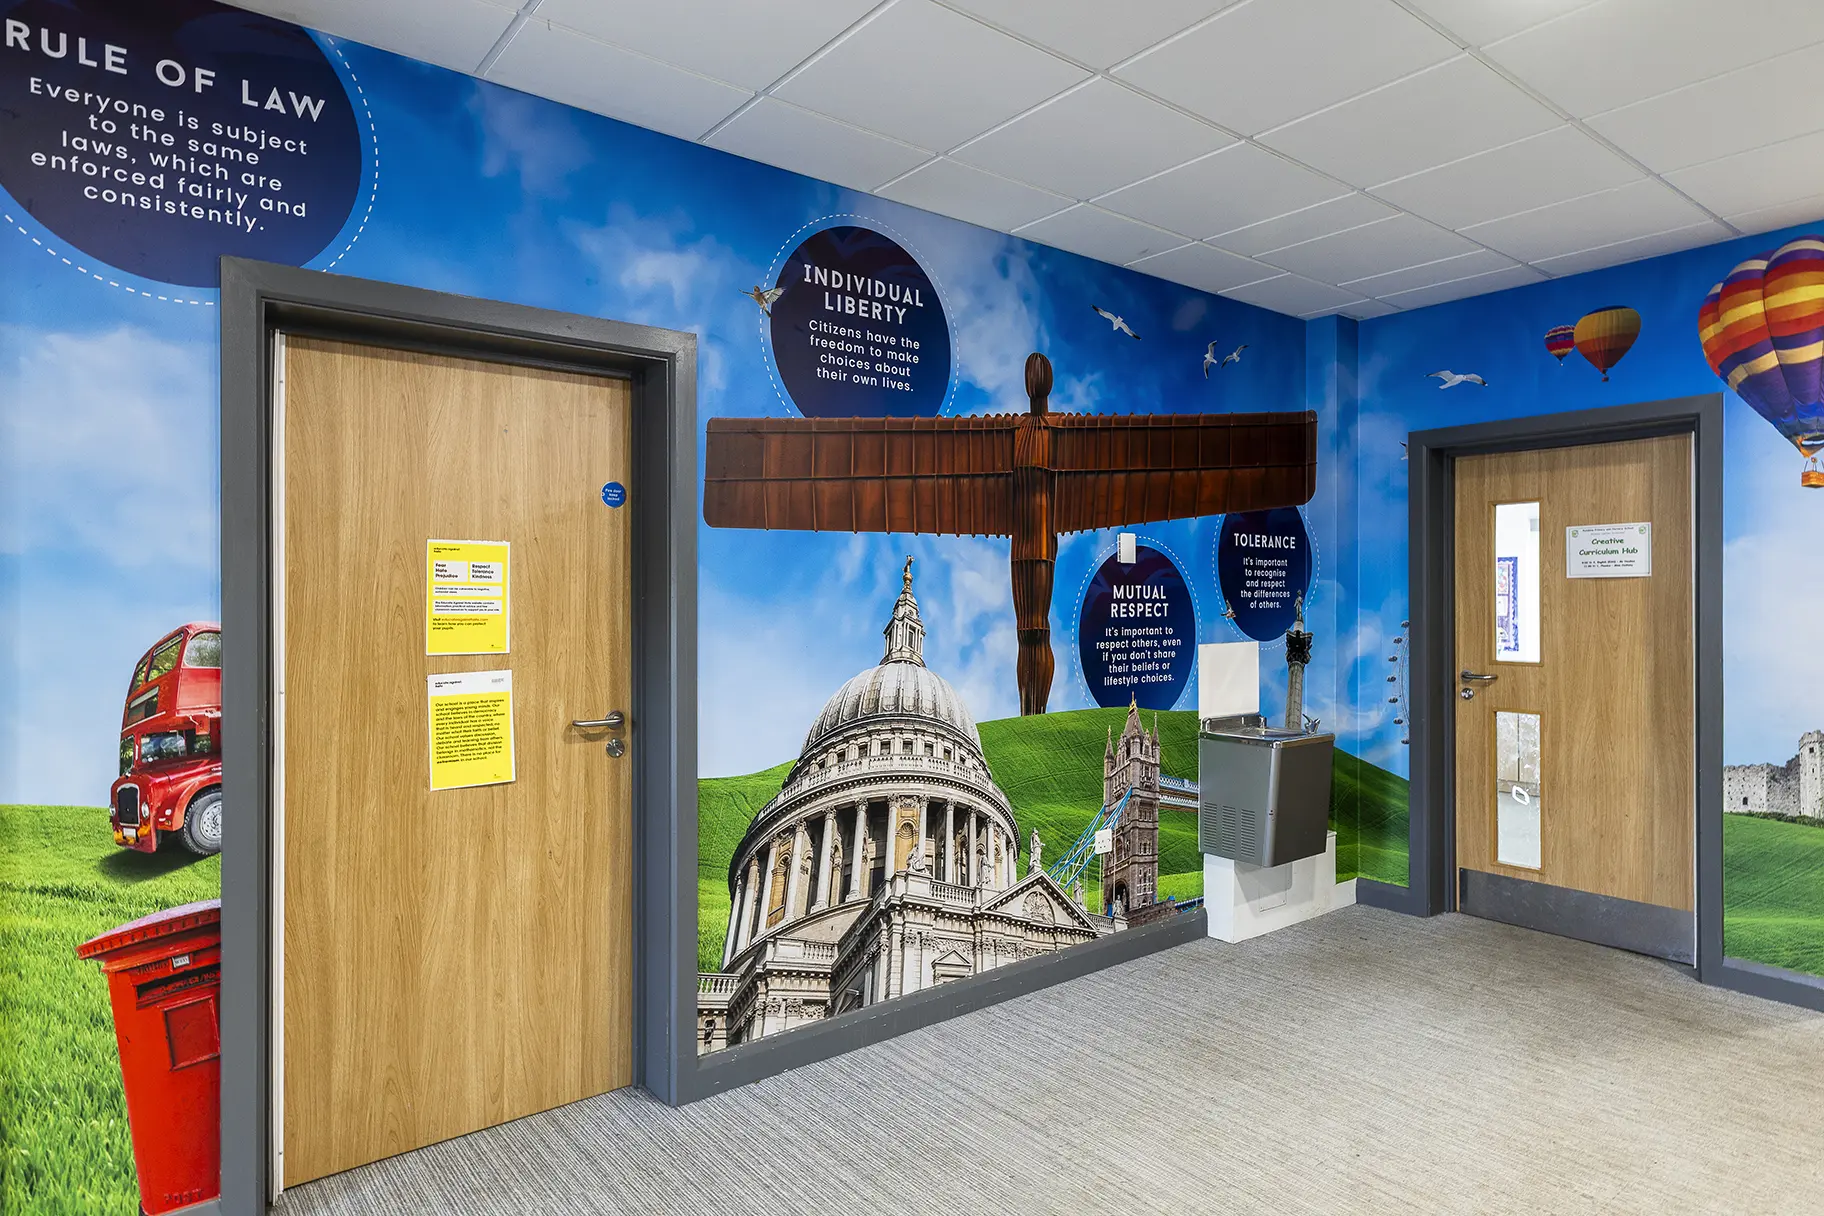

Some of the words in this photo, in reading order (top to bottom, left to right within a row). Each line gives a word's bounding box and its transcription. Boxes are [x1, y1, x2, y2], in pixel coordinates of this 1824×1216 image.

[6, 18, 128, 75] RULE
[155, 58, 216, 94] OF
[242, 79, 326, 123] LAW
[30, 77, 165, 122] Everyone
[178, 110, 199, 130] is
[211, 121, 308, 155] subject
[89, 113, 117, 134] to
[130, 123, 175, 147] the
[188, 137, 260, 166] same
[62, 130, 137, 164] laws,
[149, 150, 229, 181] which
[241, 171, 283, 192] are
[31, 150, 165, 190] enforced
[177, 178, 248, 209] fairly
[259, 195, 306, 218] and
[83, 185, 265, 232] consistently.
[804, 264, 924, 307] INDIVIDUAL
[824, 292, 907, 325] LIBERTY
[809, 320, 862, 339] Citizens
[866, 330, 896, 346] have
[901, 337, 920, 350] the
[809, 335, 865, 355] freedom
[869, 345, 882, 357] to
[887, 350, 919, 364] make
[820, 353, 870, 370] choices
[875, 362, 911, 377] about
[816, 367, 848, 382] their
[852, 374, 878, 386] own
[882, 377, 914, 392] lives.
[1234, 534, 1296, 550] TOLERANCE
[1243, 558, 1254, 566] It's
[1255, 558, 1288, 568] important
[1254, 569, 1286, 578] recognise
[1113, 585, 1167, 600] MUTUAL
[1260, 580, 1285, 589] respect
[1254, 590, 1290, 598] differences
[1111, 603, 1169, 618] RESPECT
[1250, 600, 1257, 608] of
[1106, 627, 1119, 637] It's
[1121, 627, 1163, 638] important
[1165, 626, 1174, 635] to
[1096, 640, 1129, 650] respect
[1132, 640, 1160, 649] others,
[1162, 639, 1182, 647] even
[1102, 652, 1109, 662] if
[1112, 653, 1127, 663] you
[1130, 650, 1151, 660] don't
[1154, 650, 1176, 658] share
[1108, 664, 1130, 673] their
[1132, 662, 1160, 672] beliefs
[1104, 676, 1138, 686] lifestyle
[1141, 674, 1175, 683] choices.
